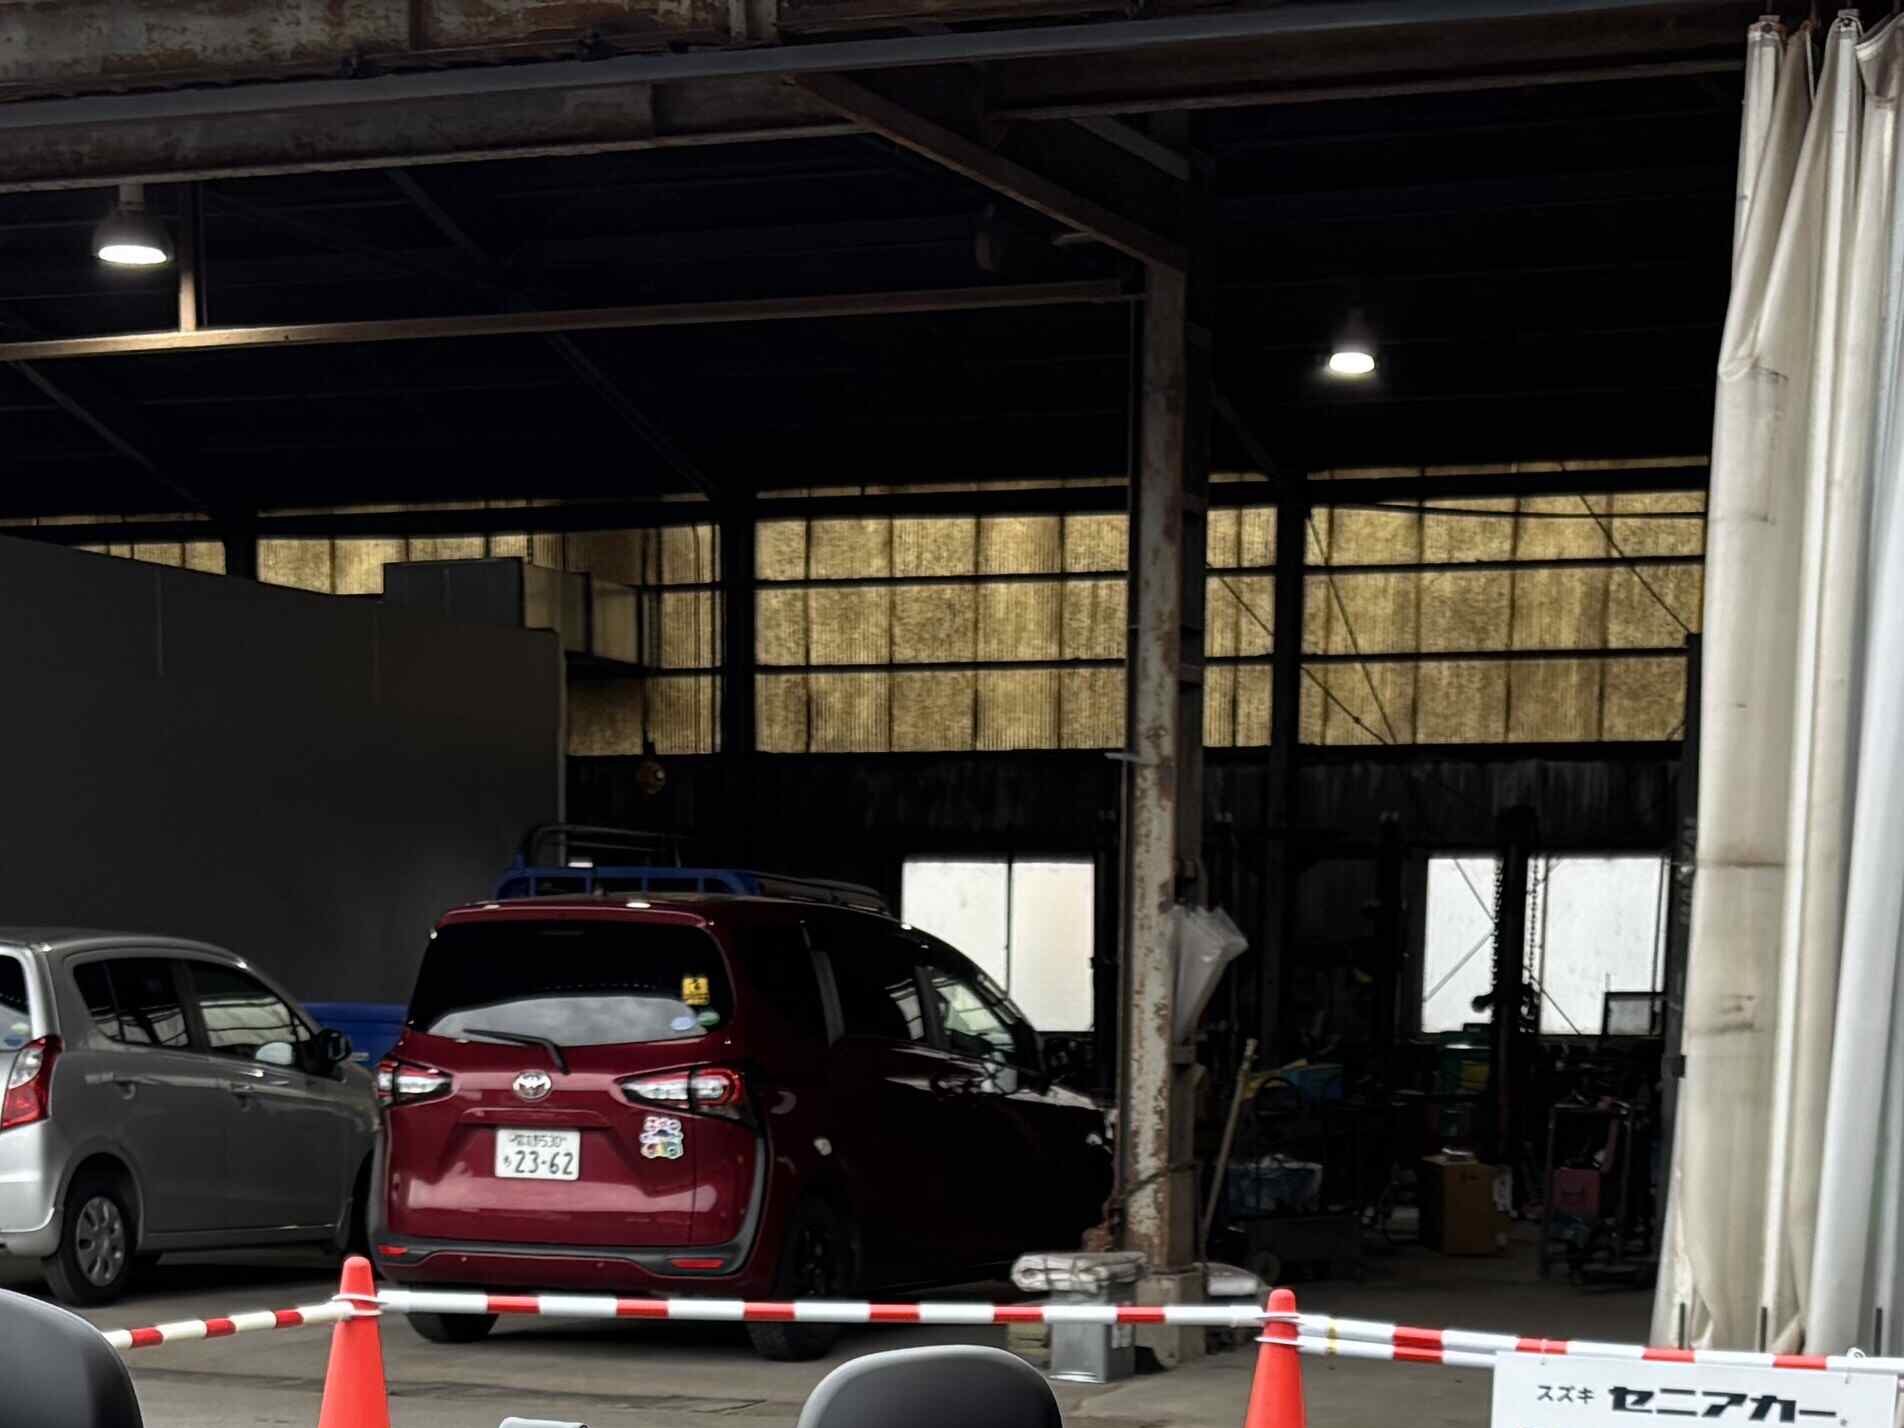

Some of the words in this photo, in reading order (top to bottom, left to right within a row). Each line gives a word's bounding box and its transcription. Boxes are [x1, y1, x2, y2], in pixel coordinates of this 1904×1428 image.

[1537, 1384, 1595, 1404] スズキ
[1608, 1386, 1838, 1424] セニアカー
